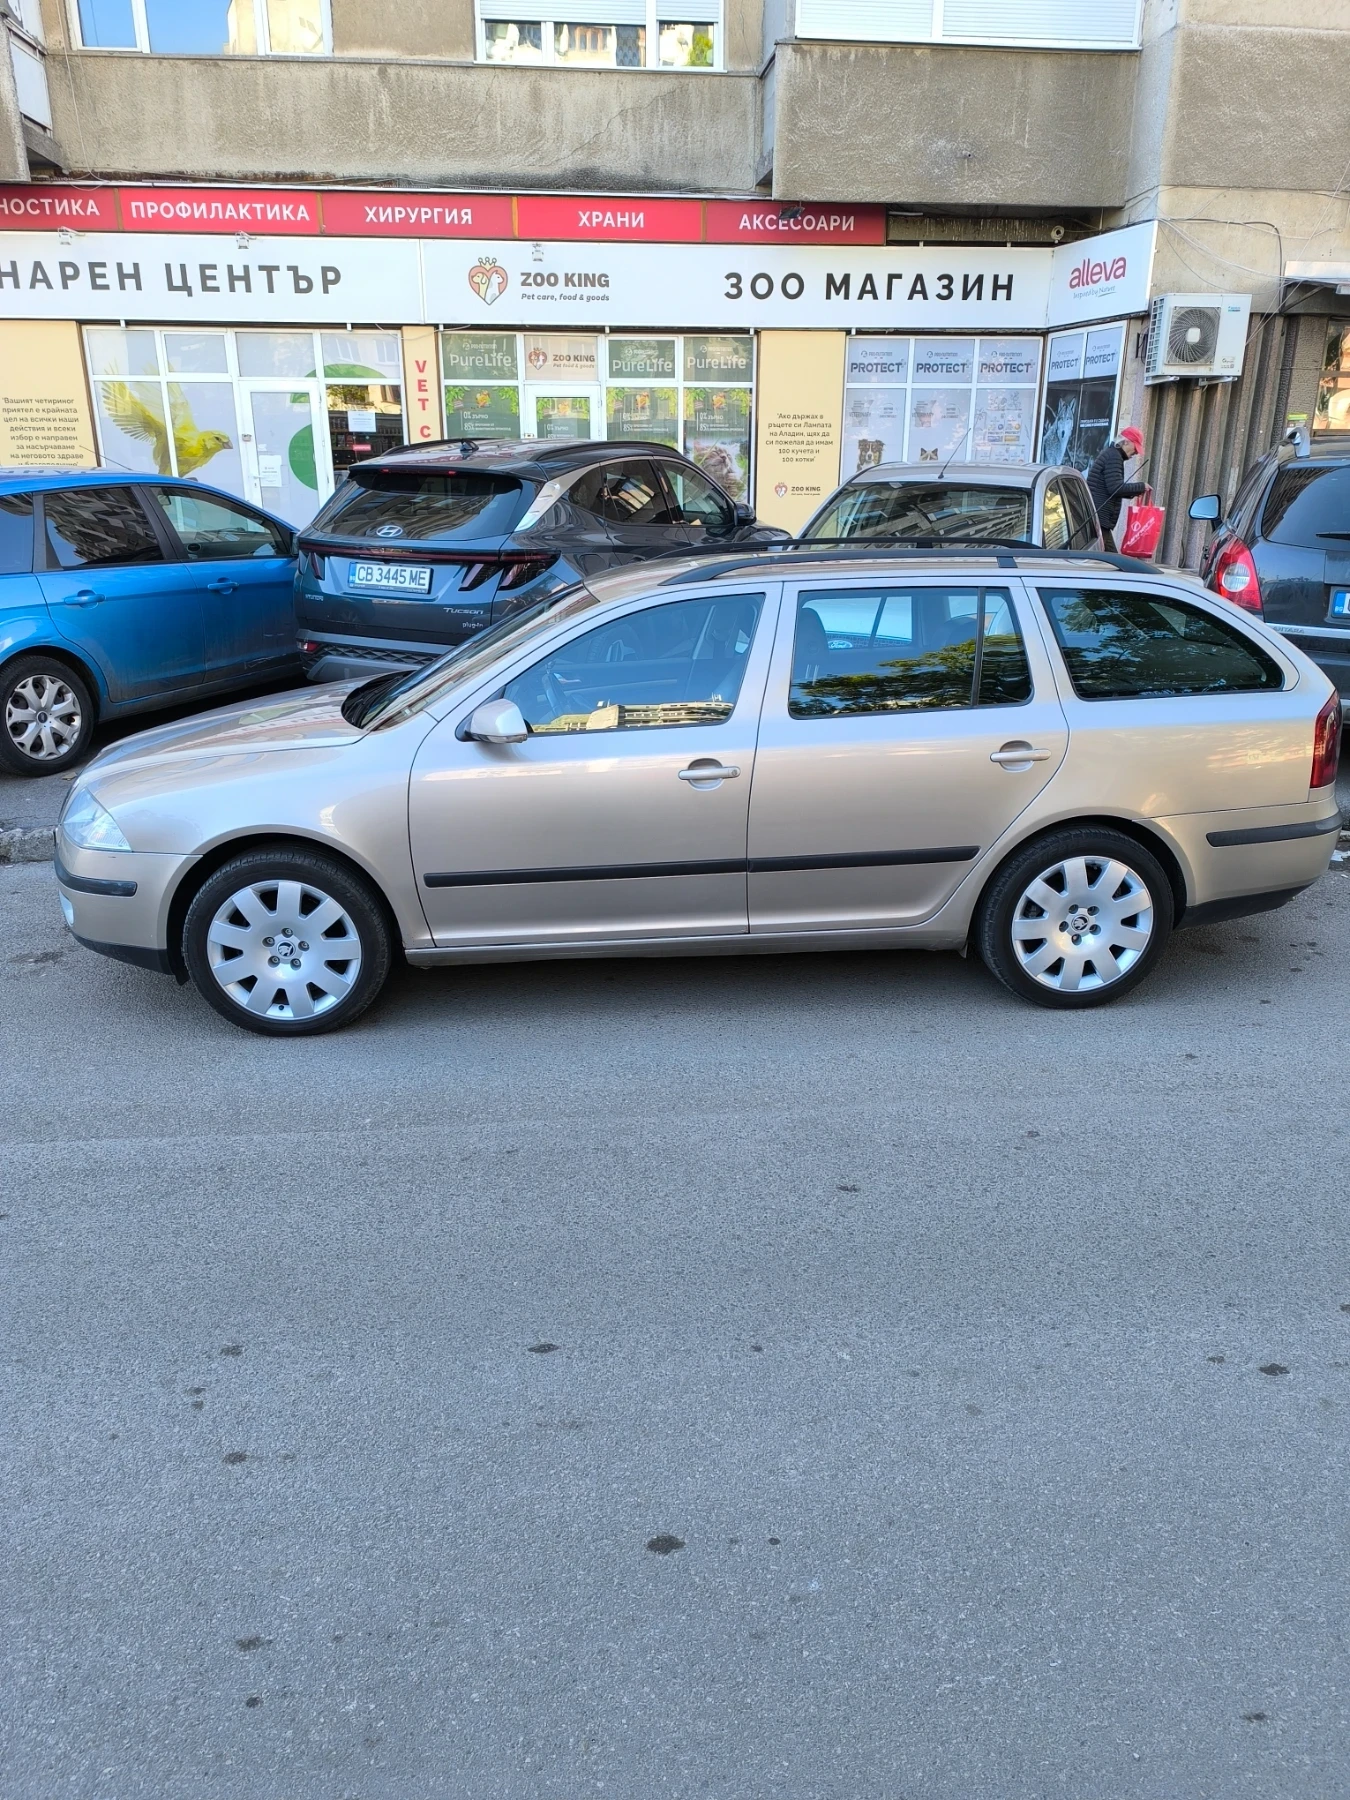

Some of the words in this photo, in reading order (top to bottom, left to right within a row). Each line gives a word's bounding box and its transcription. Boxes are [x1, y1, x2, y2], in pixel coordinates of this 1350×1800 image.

[130, 201, 310, 221] ПРОФИЛАКТИКА
[364, 206, 473, 225] ХИРУРГИЯ
[577, 210, 645, 228] ХРАНИ
[738, 213, 856, 232] АКСЕСОАРИ
[165, 263, 342, 297] ЦЕНТЪР
[520, 272, 559, 287] ZOO
[564, 272, 610, 288] KING
[1069, 256, 1127, 290] alleva
[723, 272, 805, 301] ЗОО
[826, 272, 1014, 302] МАГАЗИН
[521, 293, 535, 301] Pet
[536, 294, 557, 302] care,
[559, 293, 577, 301] food
[586, 294, 610, 303] goods
[450, 352, 512, 367] PureLife
[553, 354, 571, 362] ZOO
[573, 354, 595, 362] KING
[612, 357, 673, 372] PureLife
[687, 355, 746, 369] PureLife
[1051, 358, 1079, 370] PROTECT
[1085, 352, 1116, 365] PROTECT
[850, 363, 902, 373] PROTECT
[916, 363, 967, 373] PROTECT
[980, 363, 1031, 373] PROTECT
[42, 406, 78, 414] крайната
[357, 566, 374, 581] CB
[376, 567, 407, 584] 3445
[408, 569, 427, 587] ME
